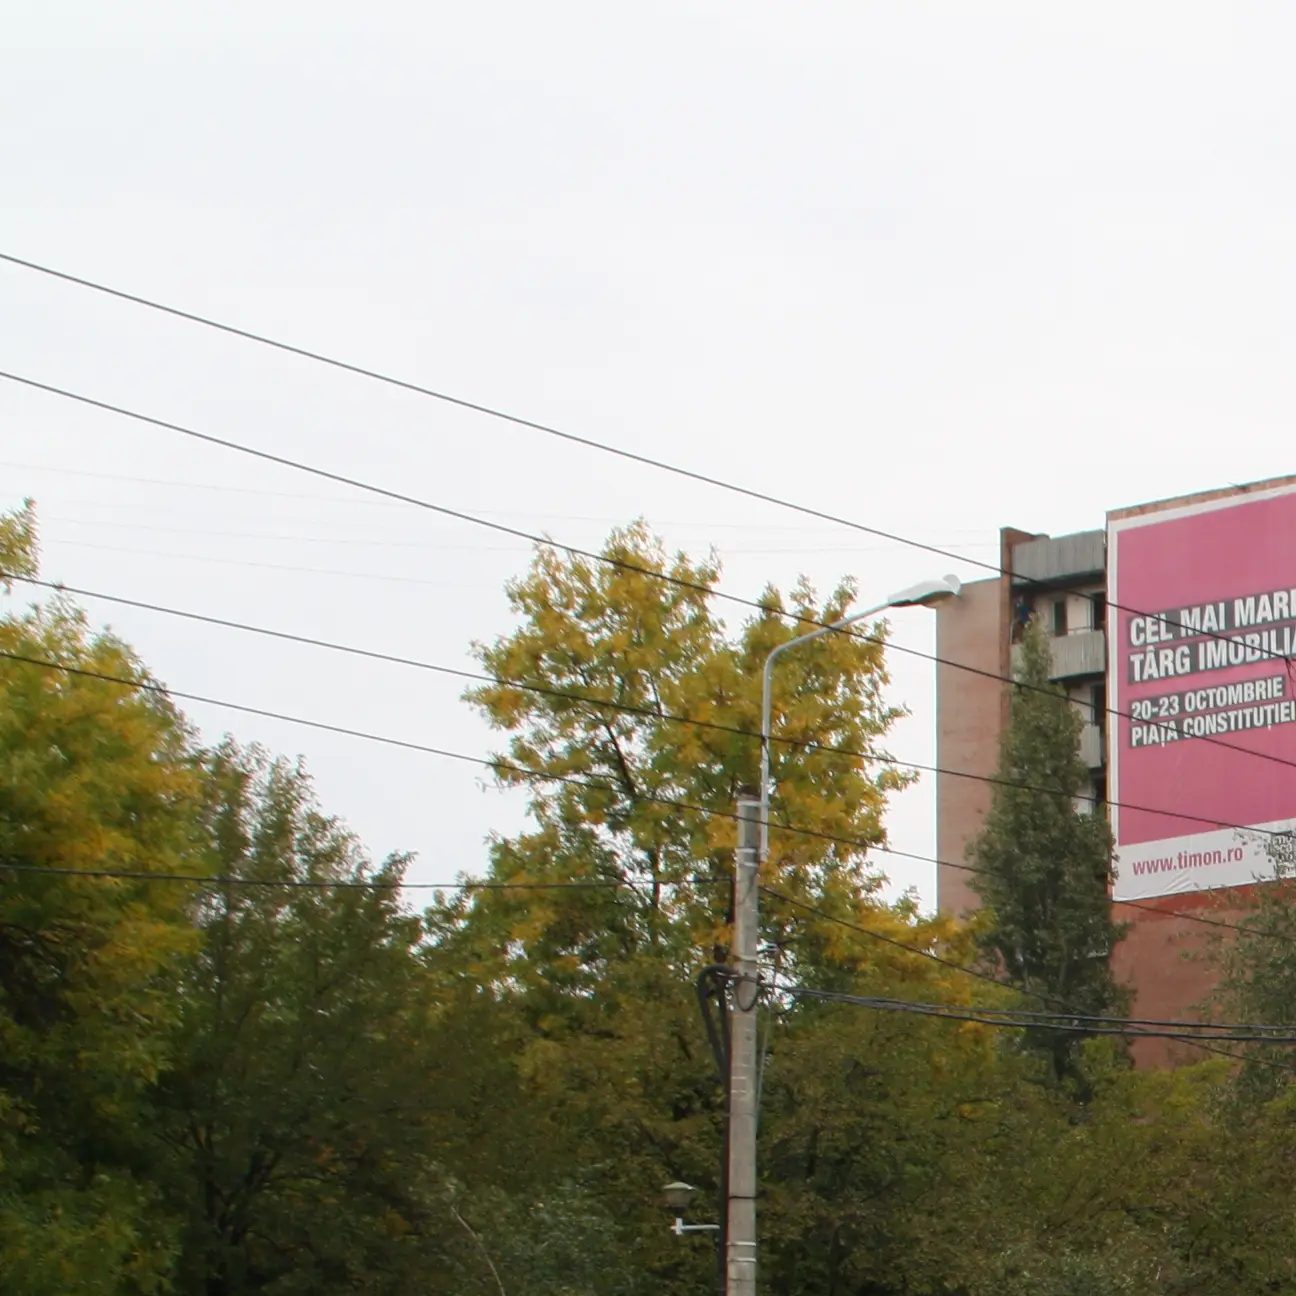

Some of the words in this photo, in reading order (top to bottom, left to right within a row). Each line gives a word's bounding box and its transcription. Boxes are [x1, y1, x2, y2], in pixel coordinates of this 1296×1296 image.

[1130, 613, 1173, 646] CEL
[1180, 602, 1226, 637] MAI
[1130, 645, 1191, 682] TÂRG
[1131, 695, 1180, 722] 20-23
[1185, 676, 1284, 712] OCTOMBRIE
[1133, 846, 1244, 875] www.timon.ro
